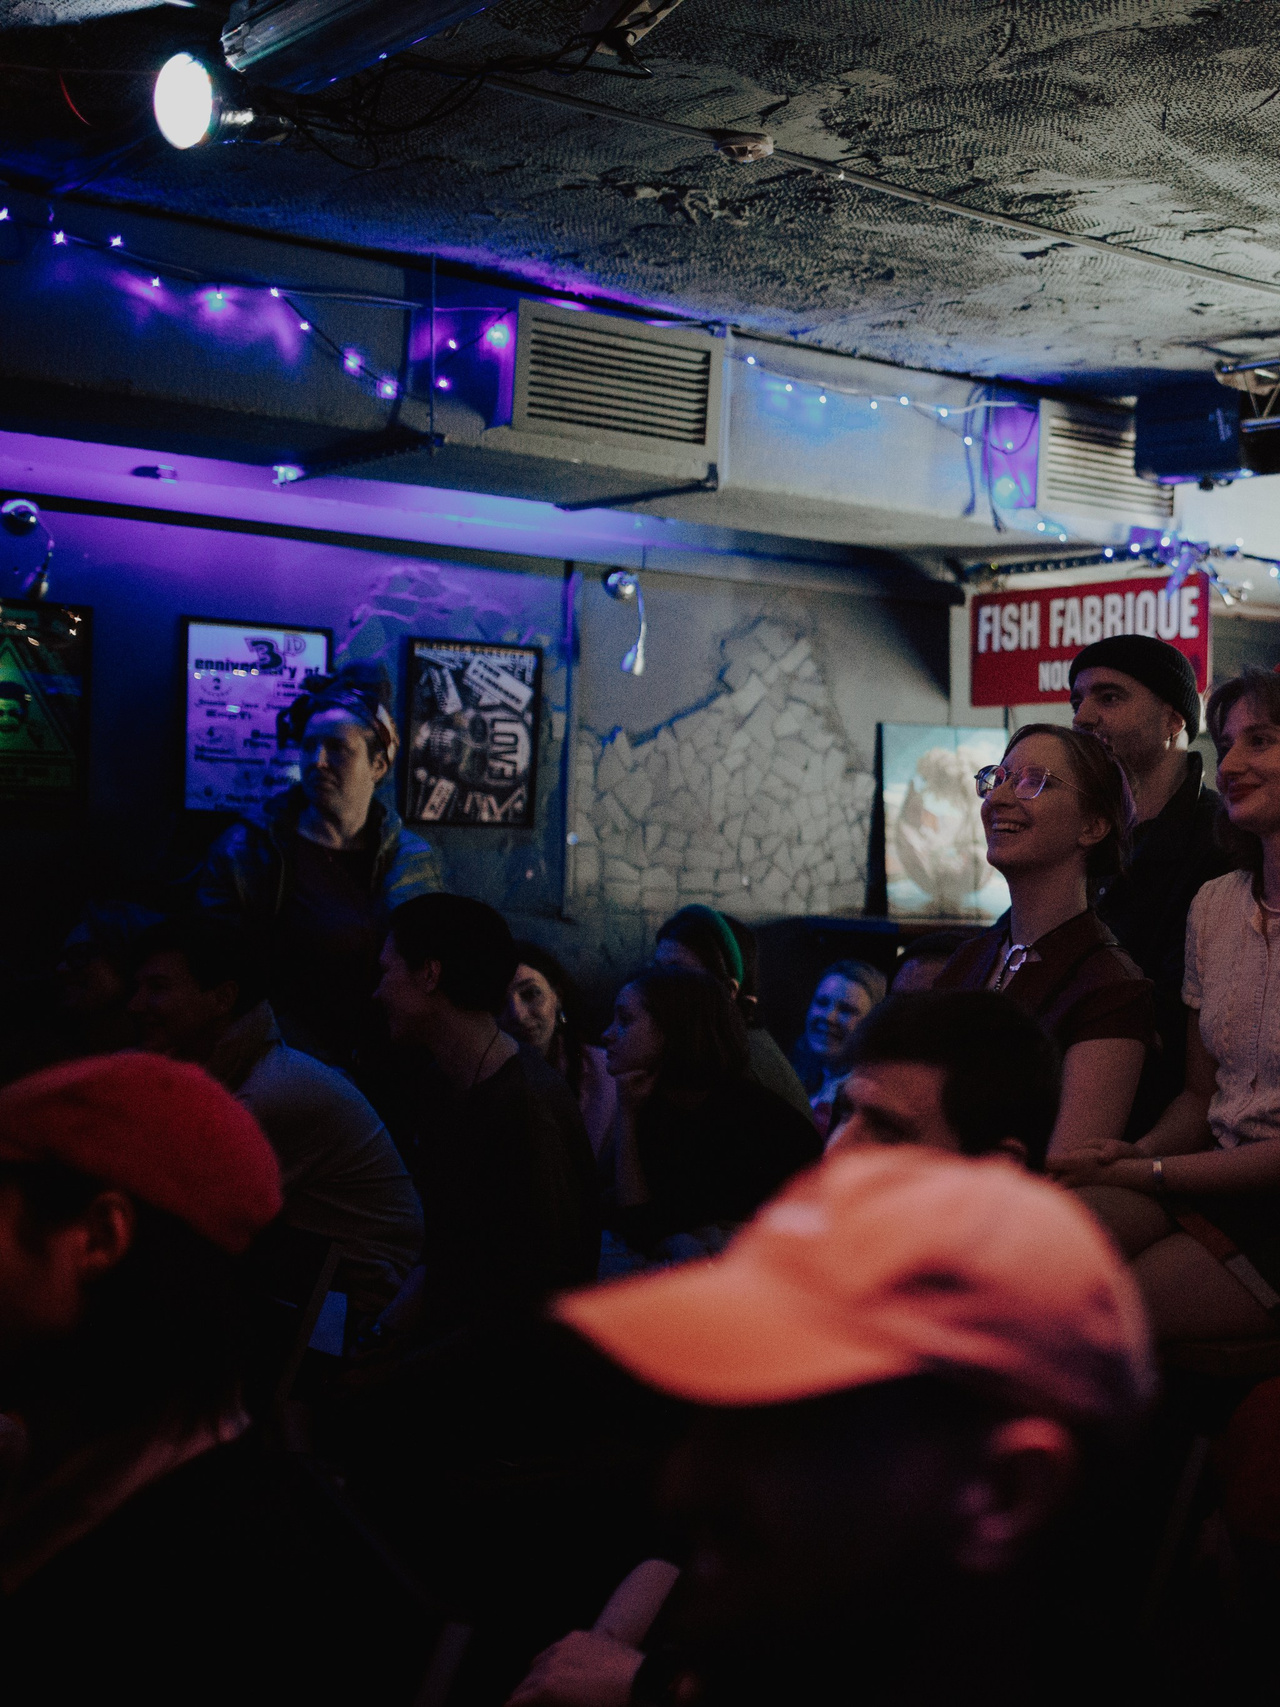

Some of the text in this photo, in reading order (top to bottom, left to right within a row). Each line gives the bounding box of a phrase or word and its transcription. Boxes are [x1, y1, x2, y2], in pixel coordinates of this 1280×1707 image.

[977, 585, 1201, 655] FISH FABRIQUE
[488, 718, 519, 781] LOVE
